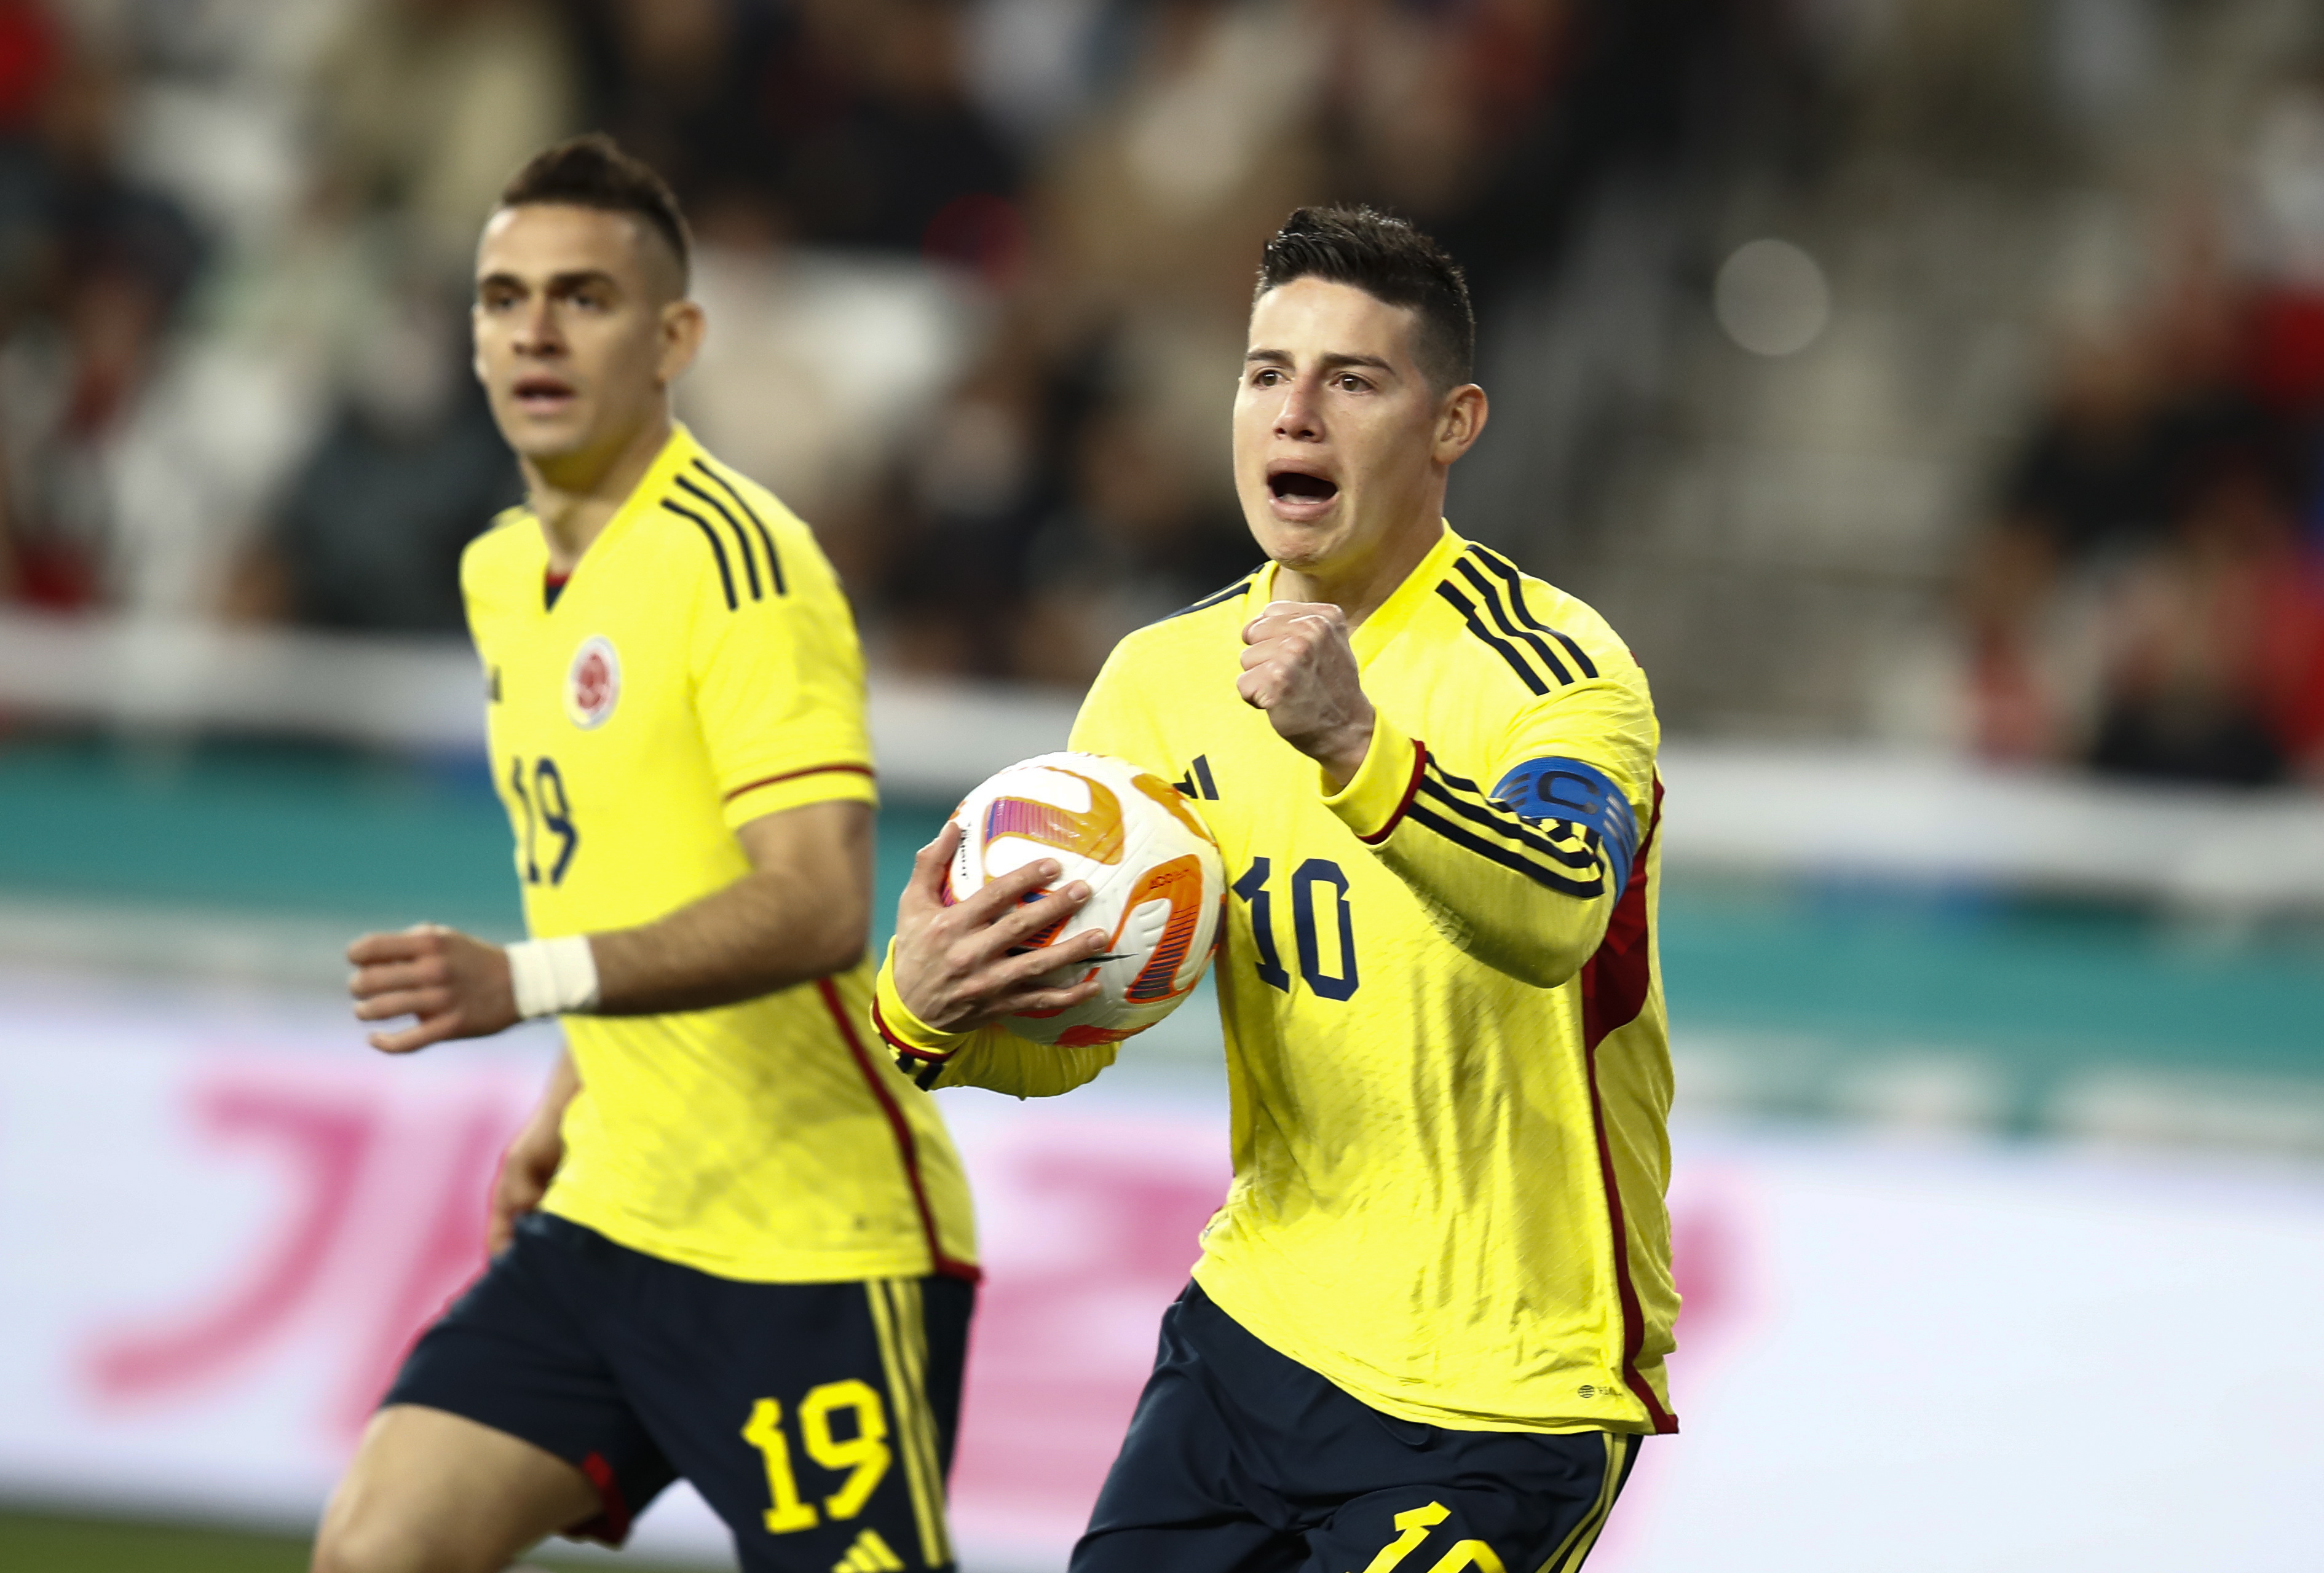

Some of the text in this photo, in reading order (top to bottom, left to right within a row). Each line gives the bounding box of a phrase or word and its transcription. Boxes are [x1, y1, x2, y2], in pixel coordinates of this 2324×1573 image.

[511, 755, 579, 885] 19
[1538, 770, 1600, 815] C
[1233, 856, 1360, 1002] 10
[741, 1379, 893, 1535] 19
